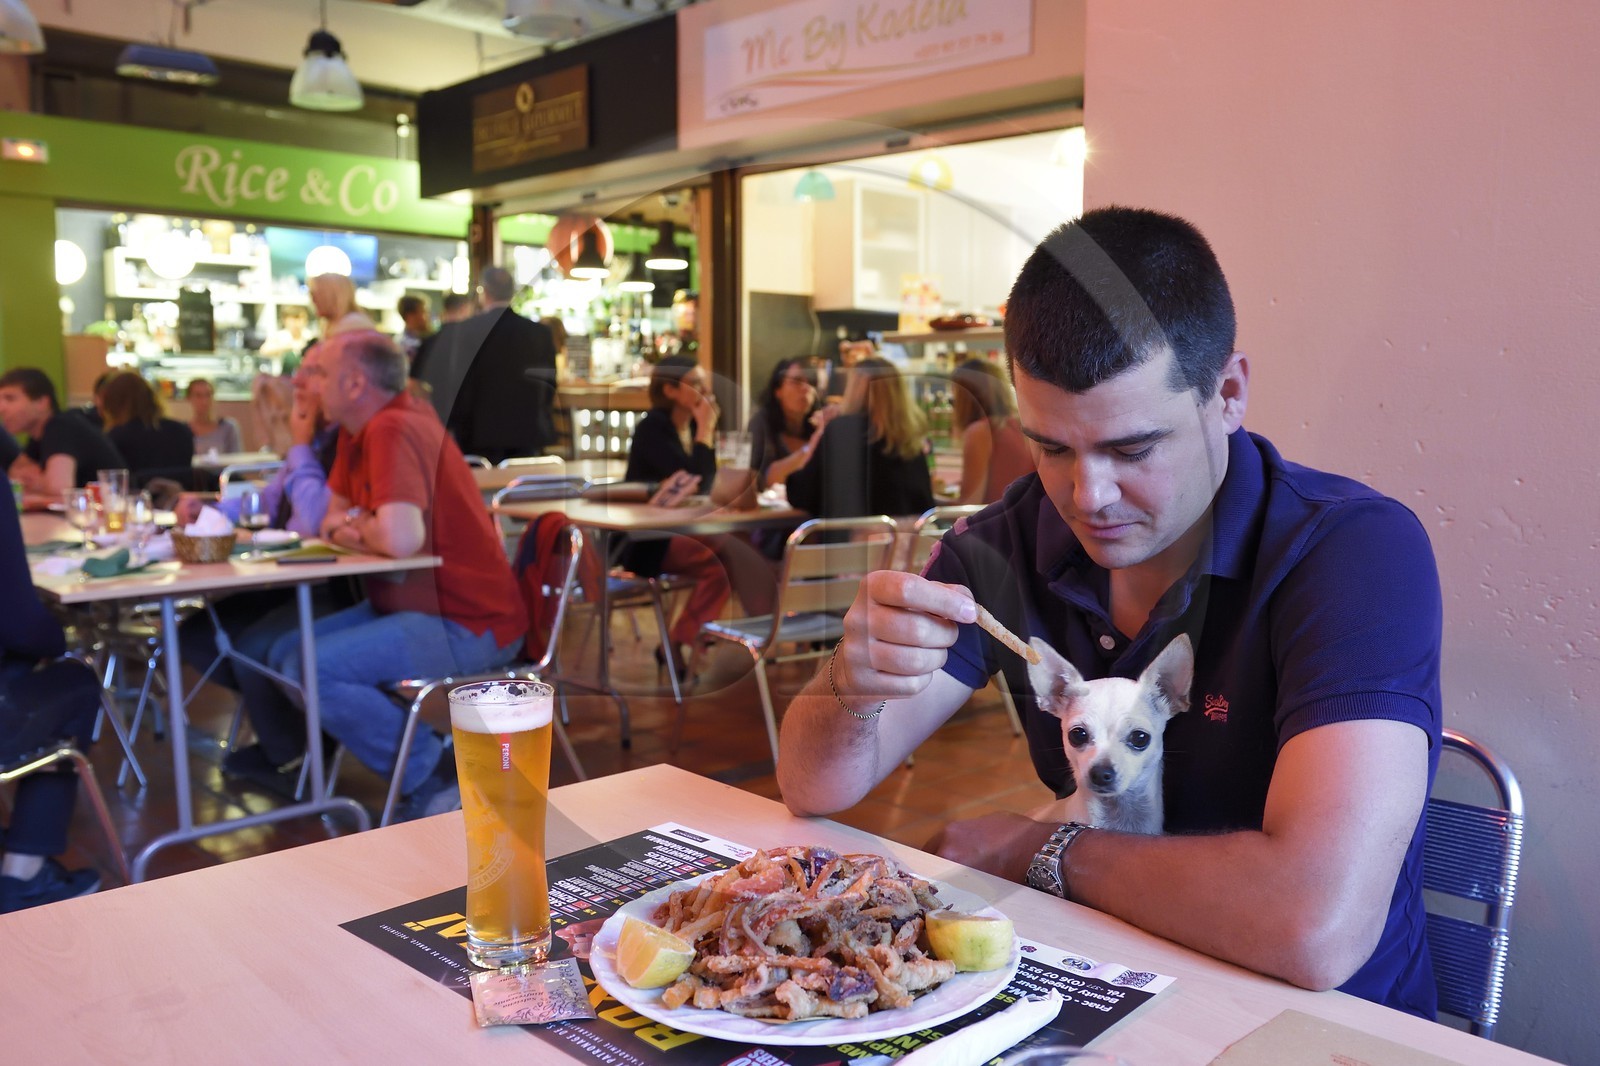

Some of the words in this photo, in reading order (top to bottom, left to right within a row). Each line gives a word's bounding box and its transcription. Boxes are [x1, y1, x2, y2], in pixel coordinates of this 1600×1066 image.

[174, 143, 290, 209] Rice
[300, 167, 334, 206] &
[339, 164, 400, 217] Co
[501, 743, 510, 770] PERONI
[1016, 969, 1039, 981] Mon
[1028, 966, 1043, 974] 93
[1042, 971, 1059, 979] 07
[1039, 977, 1078, 993] Angels
[1059, 975, 1086, 987] (0)6
[1078, 989, 1120, 1004] Beauty
[1107, 988, 1126, 998] Tél.
[1081, 1001, 1113, 1012] Fnac
[554, 1027, 565, 1037] DE
[565, 1033, 617, 1066] PATRONAGE
